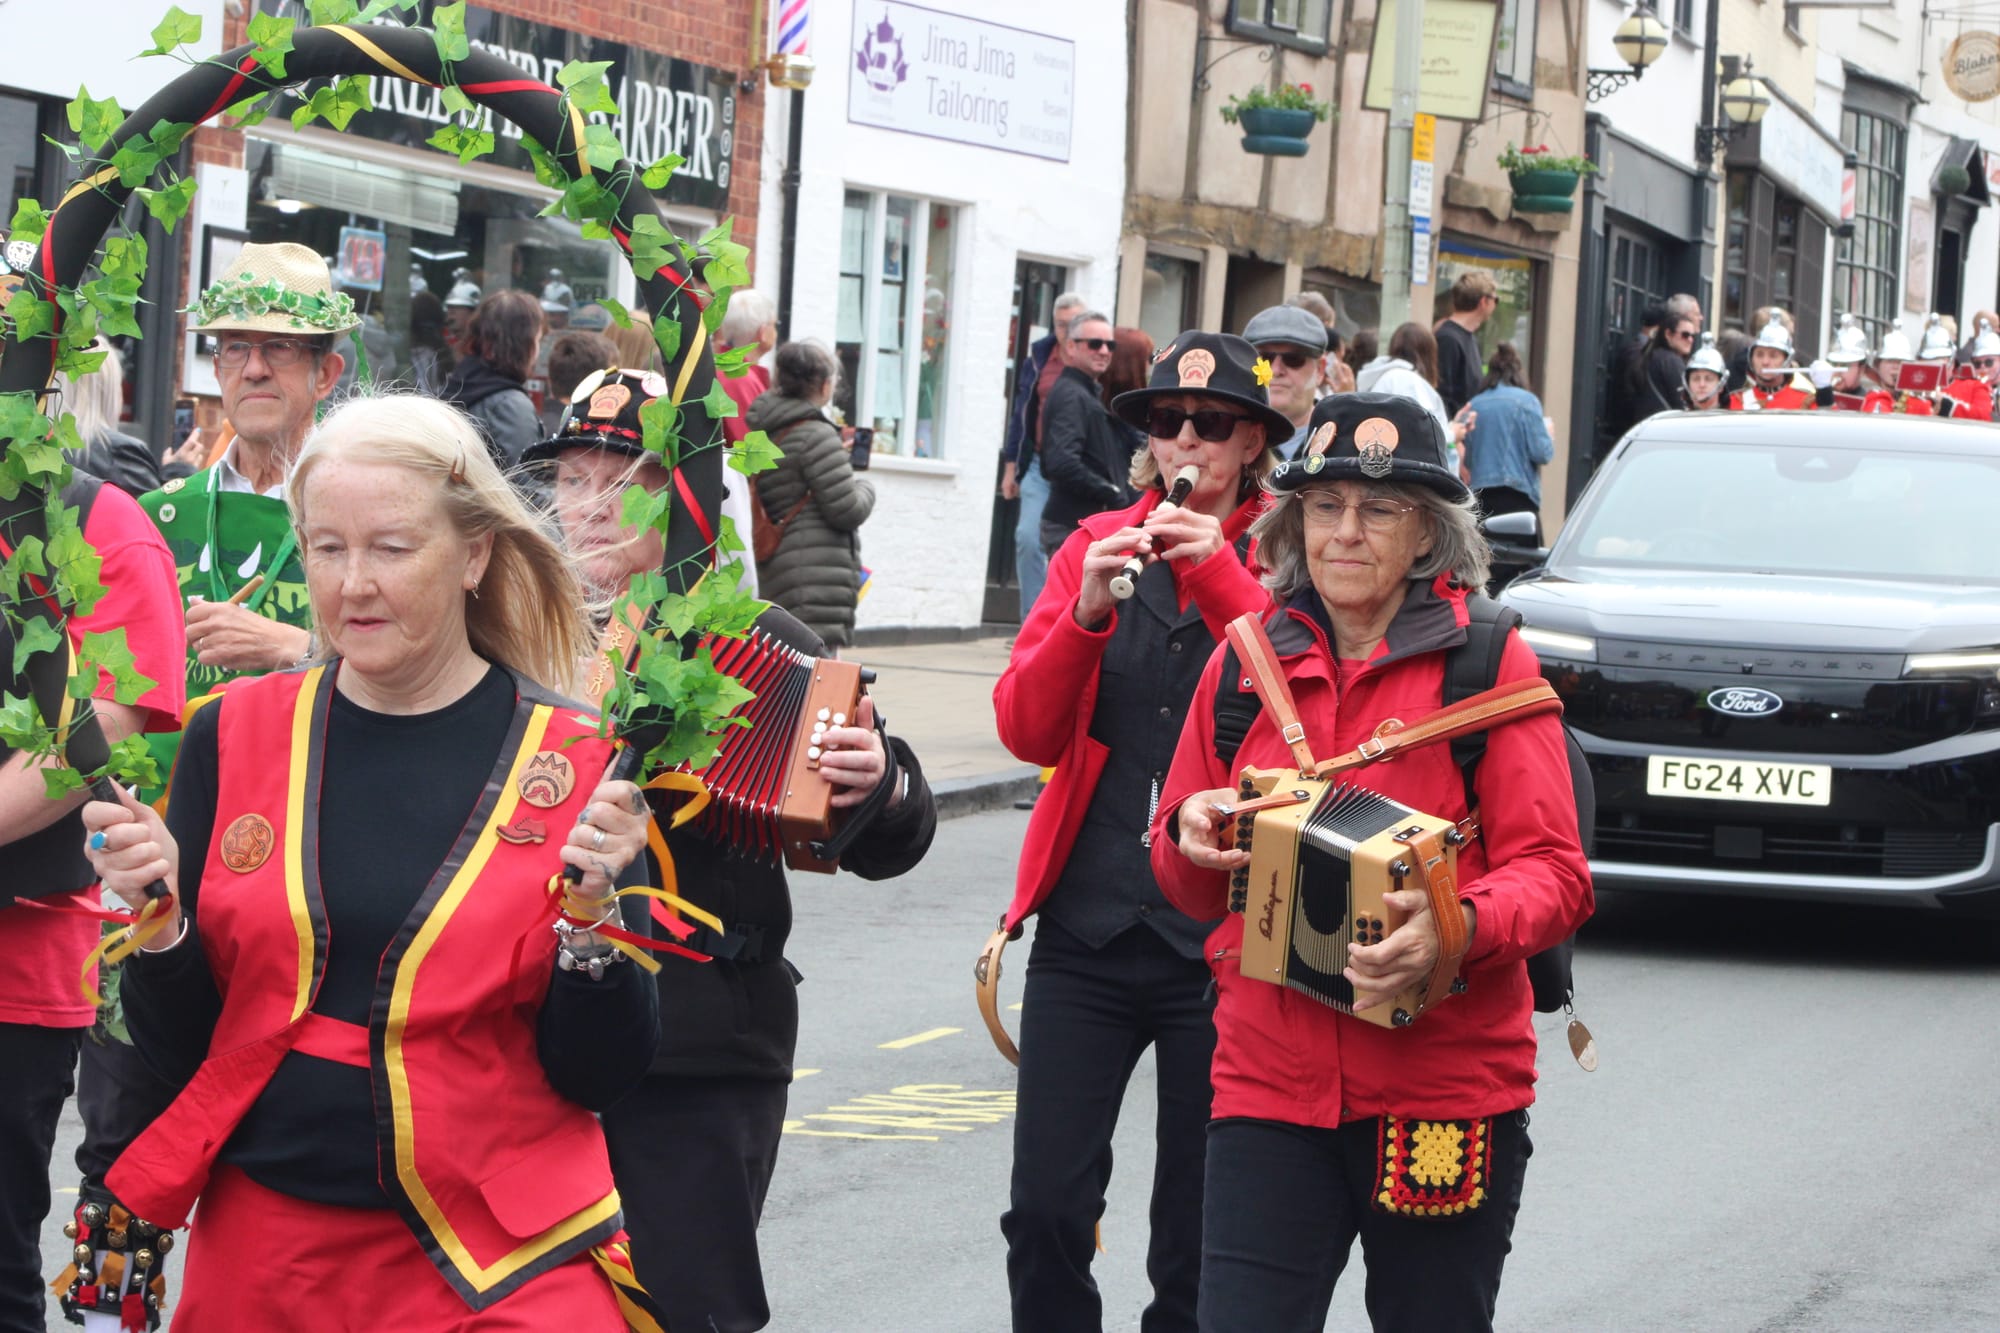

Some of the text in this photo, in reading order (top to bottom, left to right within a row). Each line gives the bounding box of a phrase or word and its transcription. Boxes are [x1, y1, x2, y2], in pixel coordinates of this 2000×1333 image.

[921, 24, 1015, 80] Jima Jima
[926, 75, 1009, 138] Tailoring
[1721, 690, 1767, 712] Ford
[1661, 760, 1816, 798] FG24 XVC
